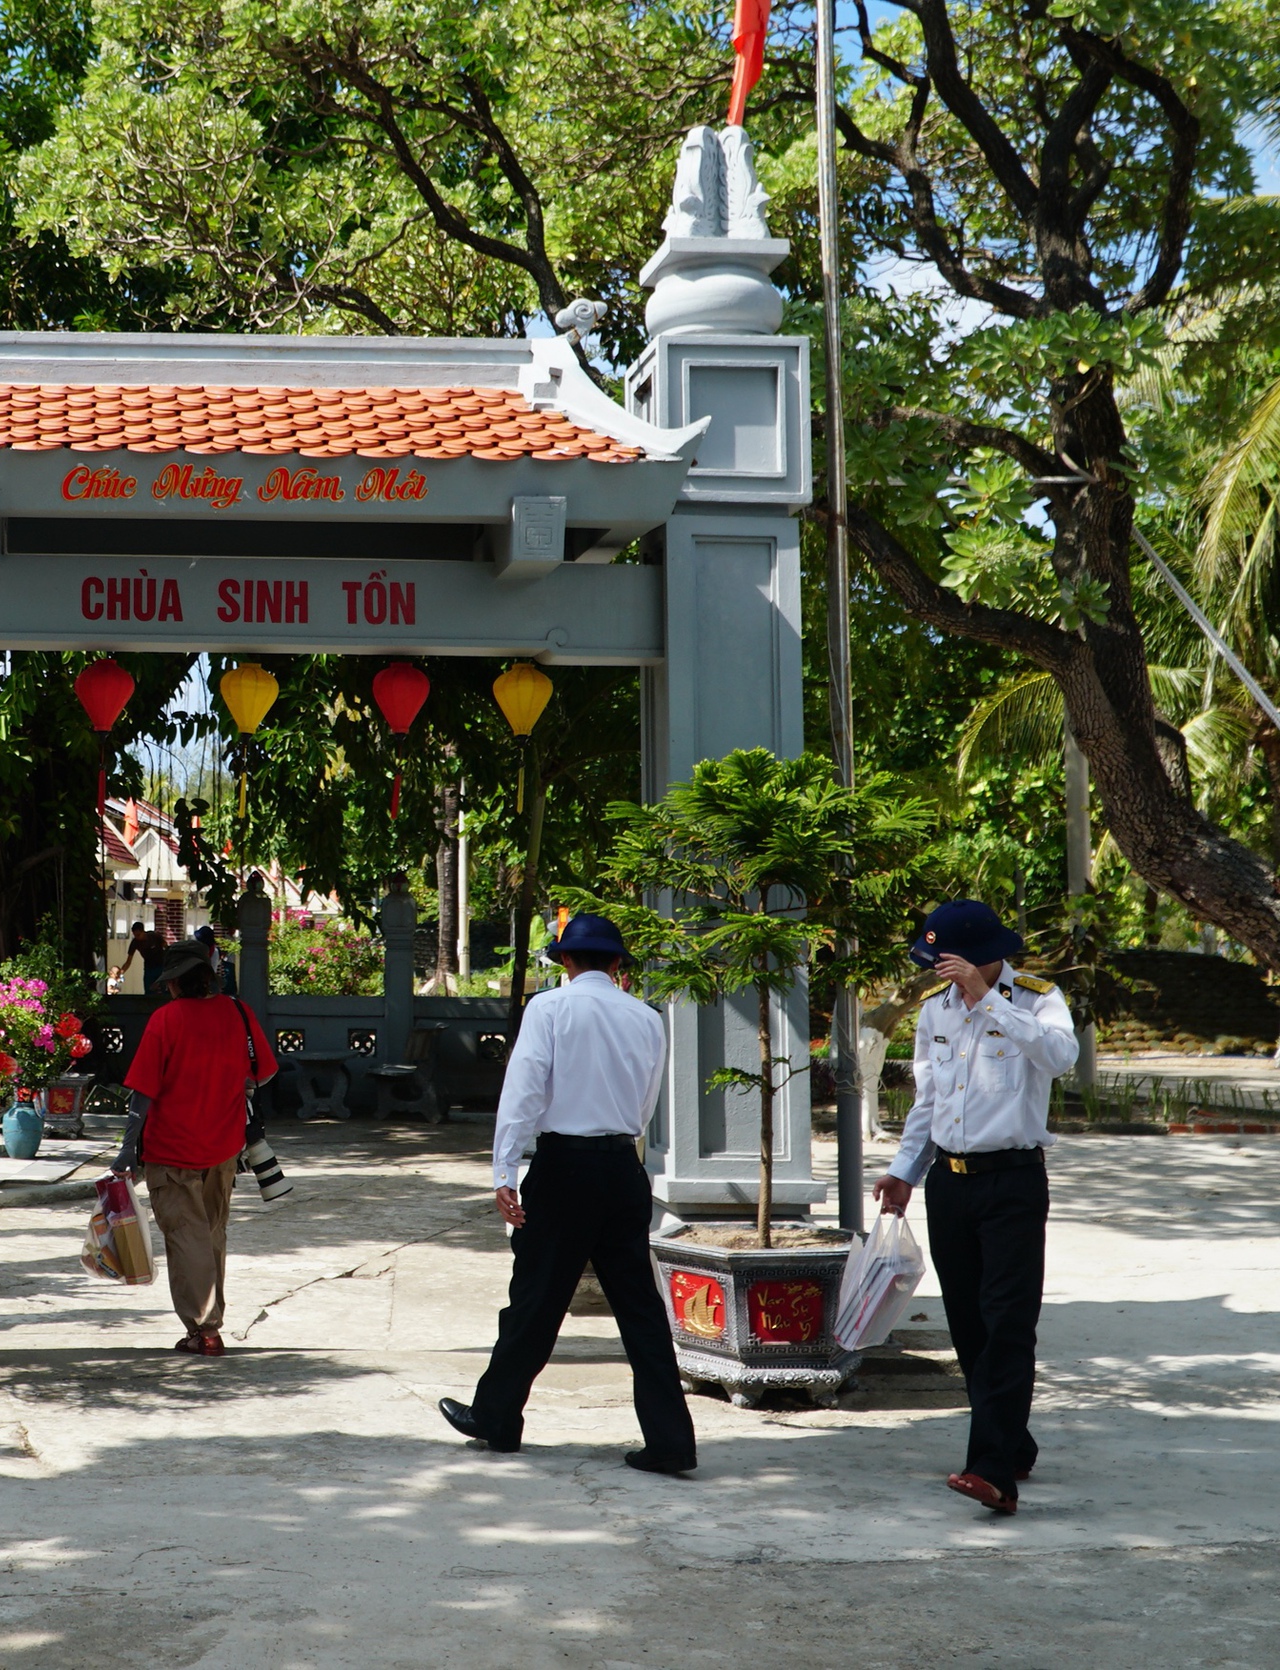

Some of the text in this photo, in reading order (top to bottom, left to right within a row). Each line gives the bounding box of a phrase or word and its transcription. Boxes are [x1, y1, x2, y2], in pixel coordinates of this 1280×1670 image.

[61, 463, 429, 509] Chúc Mừng Năm Mới
[81, 569, 416, 625] CHÙA SINH TỒN
